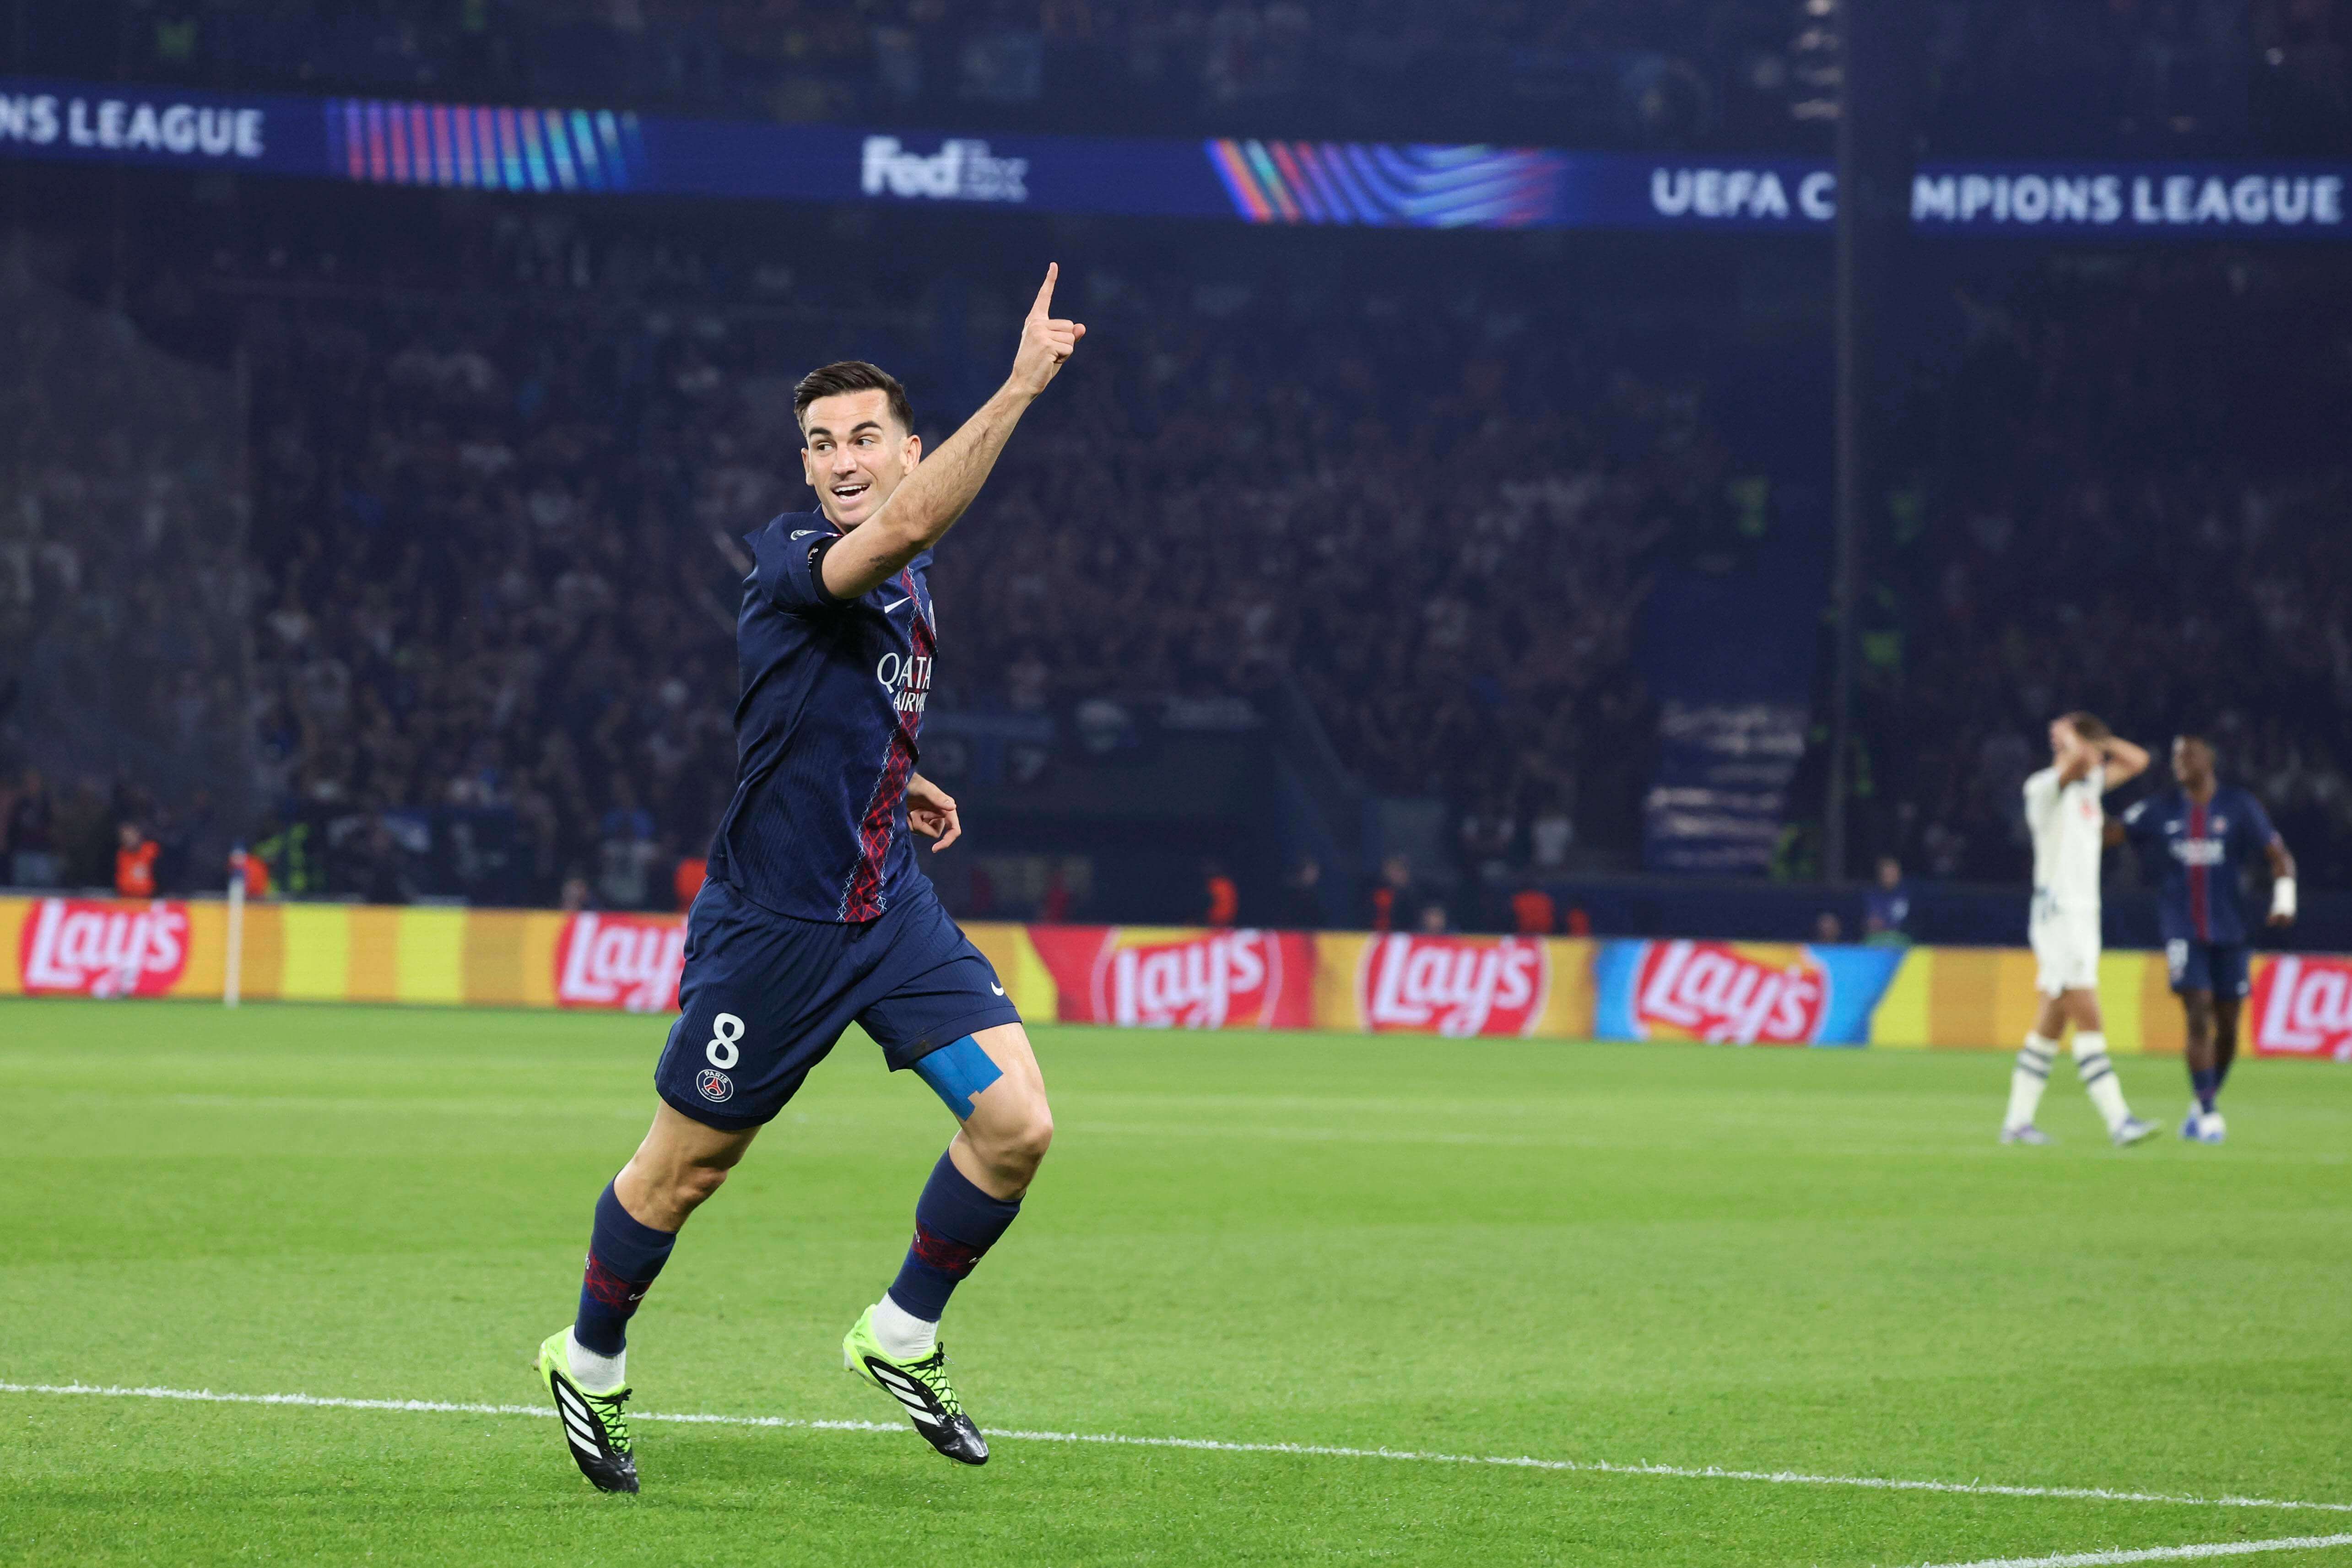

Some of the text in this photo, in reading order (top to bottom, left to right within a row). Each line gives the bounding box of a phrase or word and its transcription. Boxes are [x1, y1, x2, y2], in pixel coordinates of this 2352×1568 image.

[68, 98, 265, 157] LEAGUE
[862, 136, 1028, 201] FedEx
[1650, 168, 2343, 225] UEFA CMPIONS LEAGUE
[877, 652, 932, 694] QATA
[25, 897, 188, 999] Lay's
[561, 912, 687, 1013] Lay
[1373, 932, 1537, 1038] Lay's
[1642, 938, 1818, 1046] Lay's
[706, 1012, 745, 1069] 8
[704, 1071, 729, 1083] PARIS
